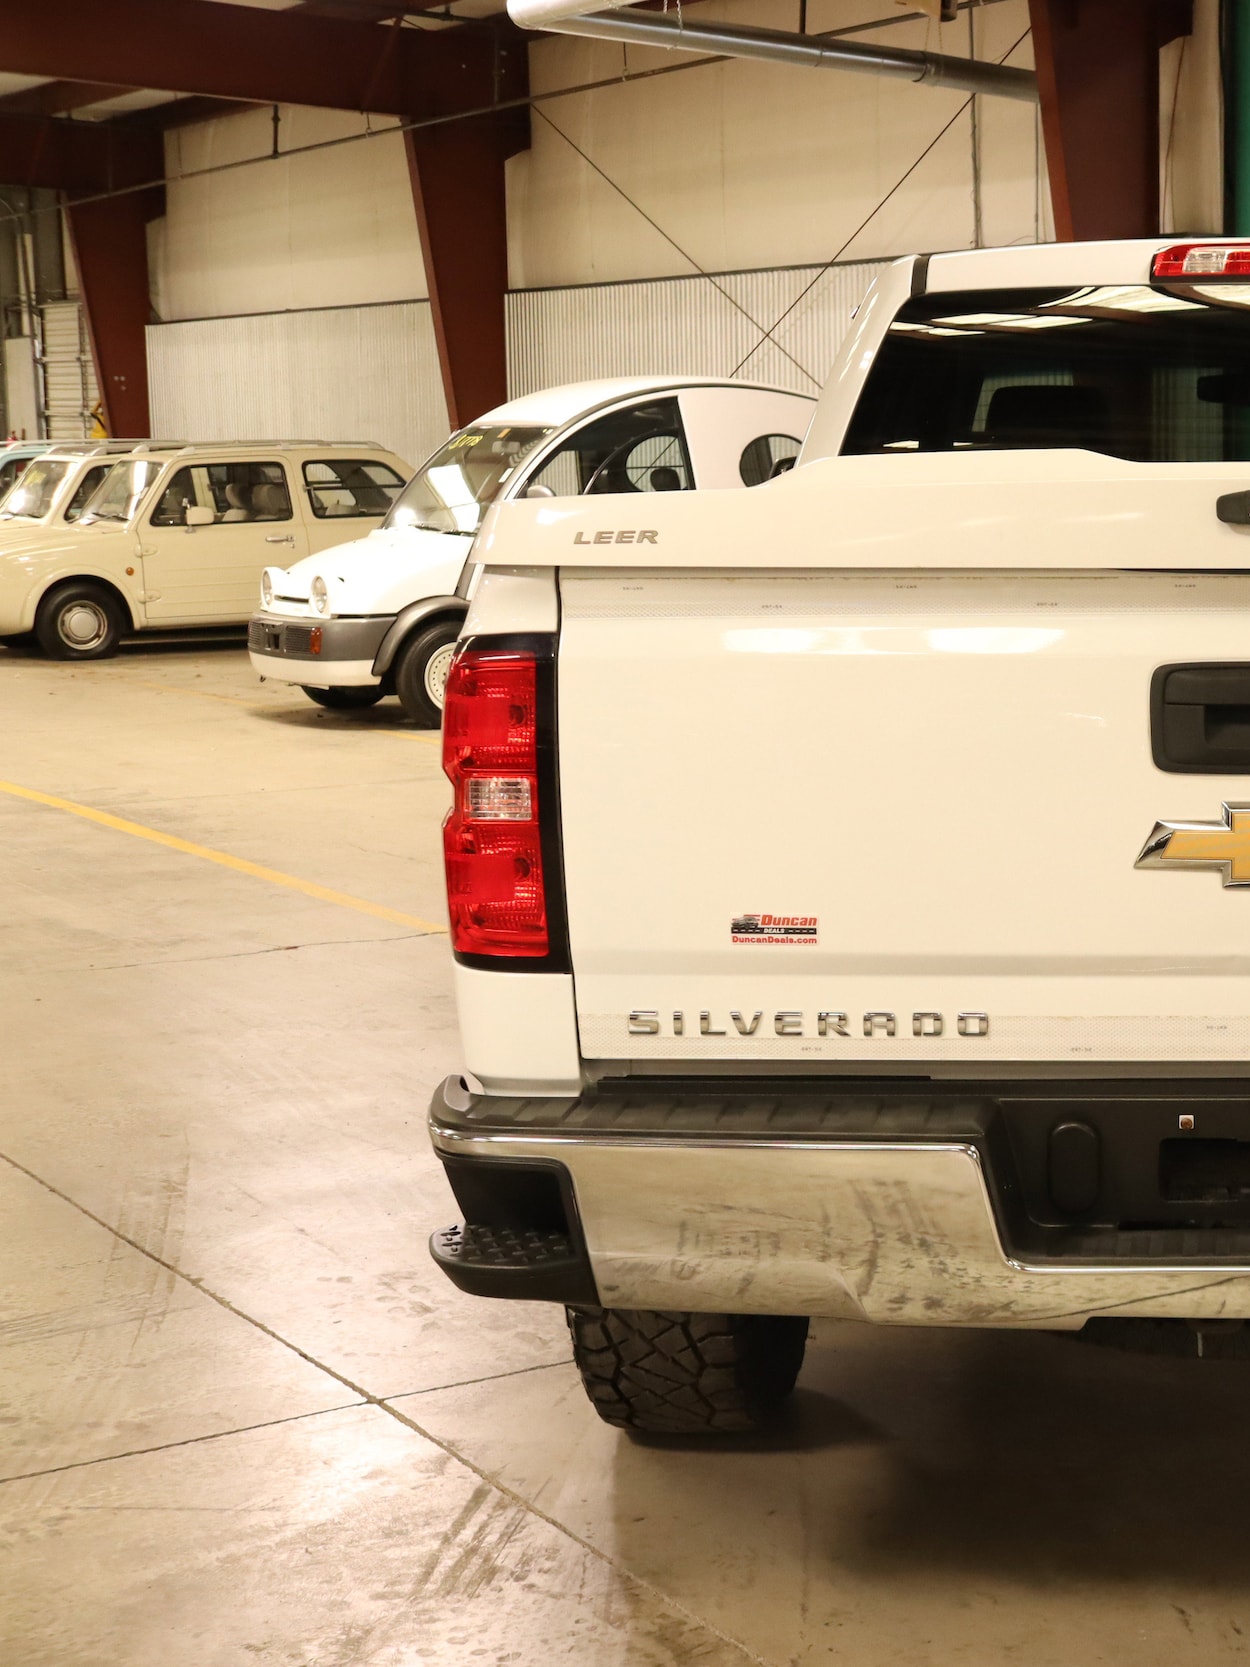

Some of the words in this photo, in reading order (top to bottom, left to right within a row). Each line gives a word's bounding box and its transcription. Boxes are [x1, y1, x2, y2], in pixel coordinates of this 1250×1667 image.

[573, 530, 659, 545] LEER
[760, 914, 817, 926] Duncan
[731, 935, 818, 944] DuncanDeals.com
[628, 1010, 991, 1037] SILVERADO
